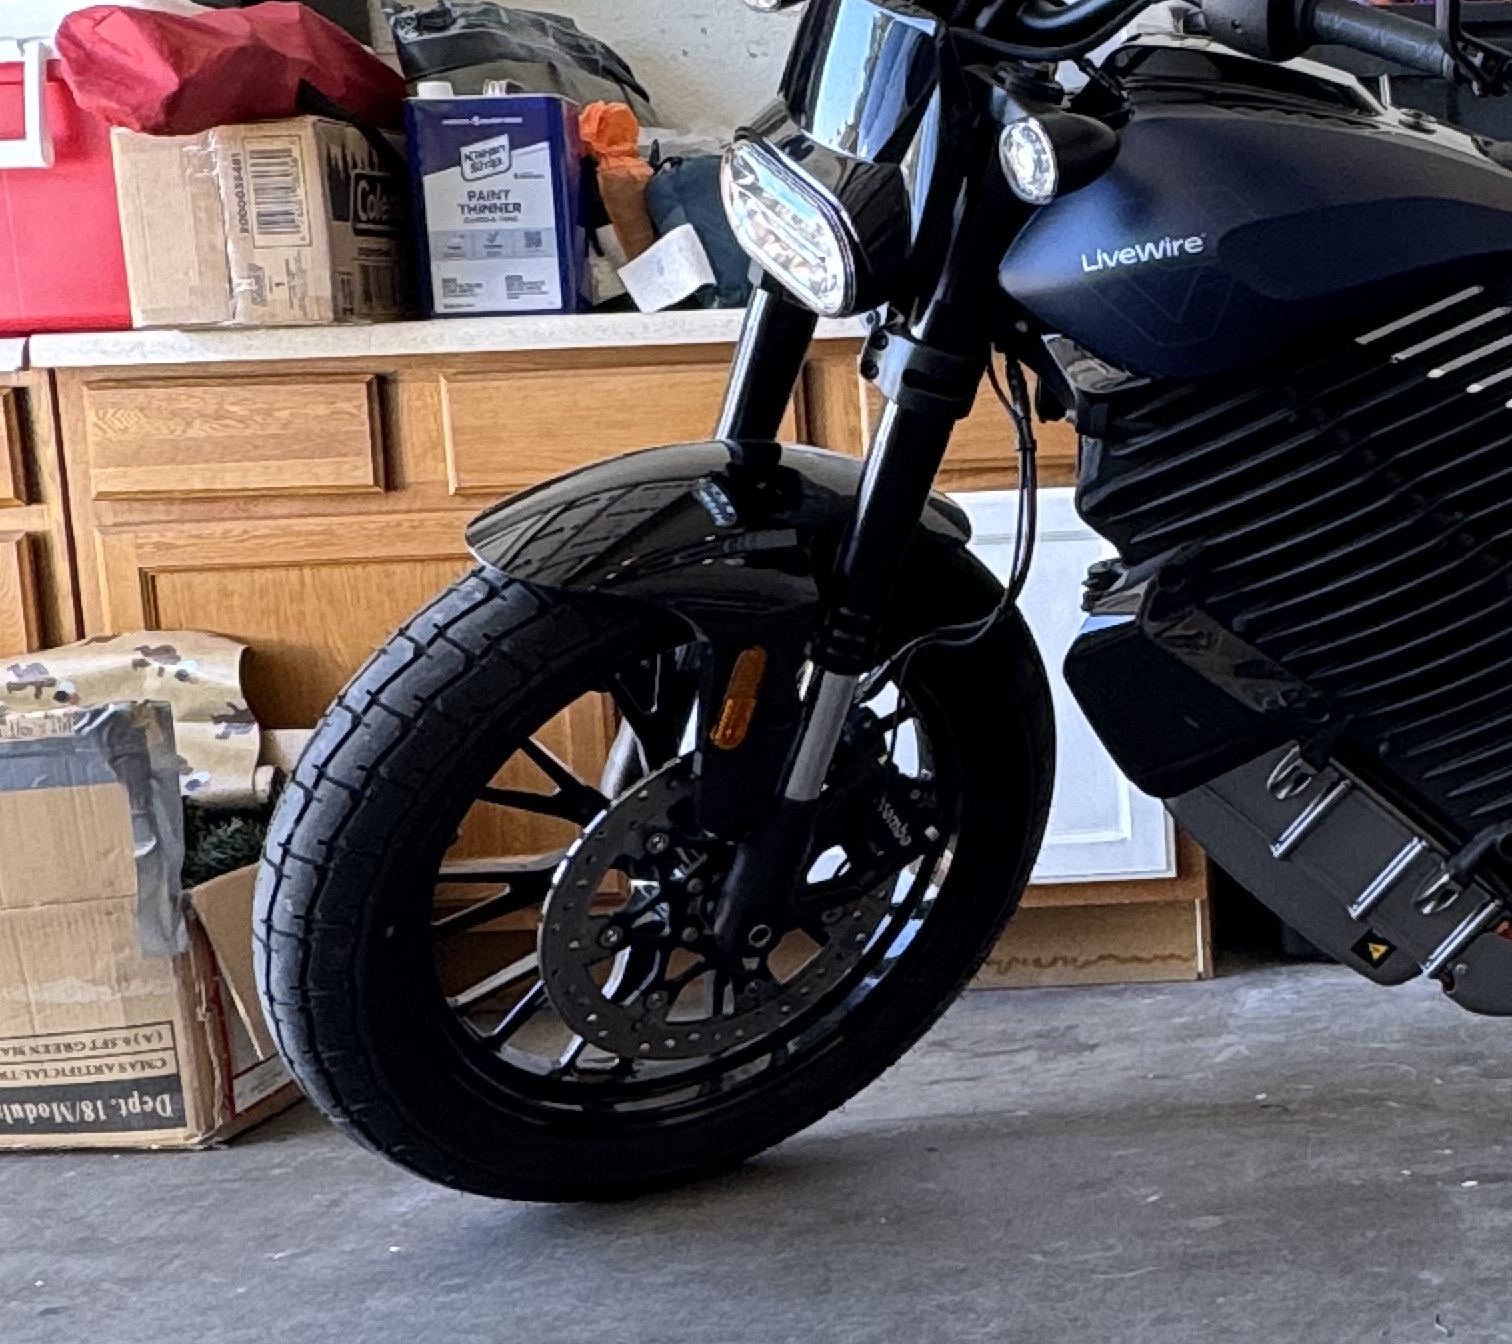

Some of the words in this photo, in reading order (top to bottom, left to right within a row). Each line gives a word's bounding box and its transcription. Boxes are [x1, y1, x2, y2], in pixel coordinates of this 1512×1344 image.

[357, 178, 401, 222] Cole
[457, 202, 522, 215] THINNER
[467, 188, 511, 202] PAINT
[1081, 236, 1204, 272] LiveWire
[0, 1099, 107, 1125] 18/Modul
[110, 1090, 174, 1118] Dept.
